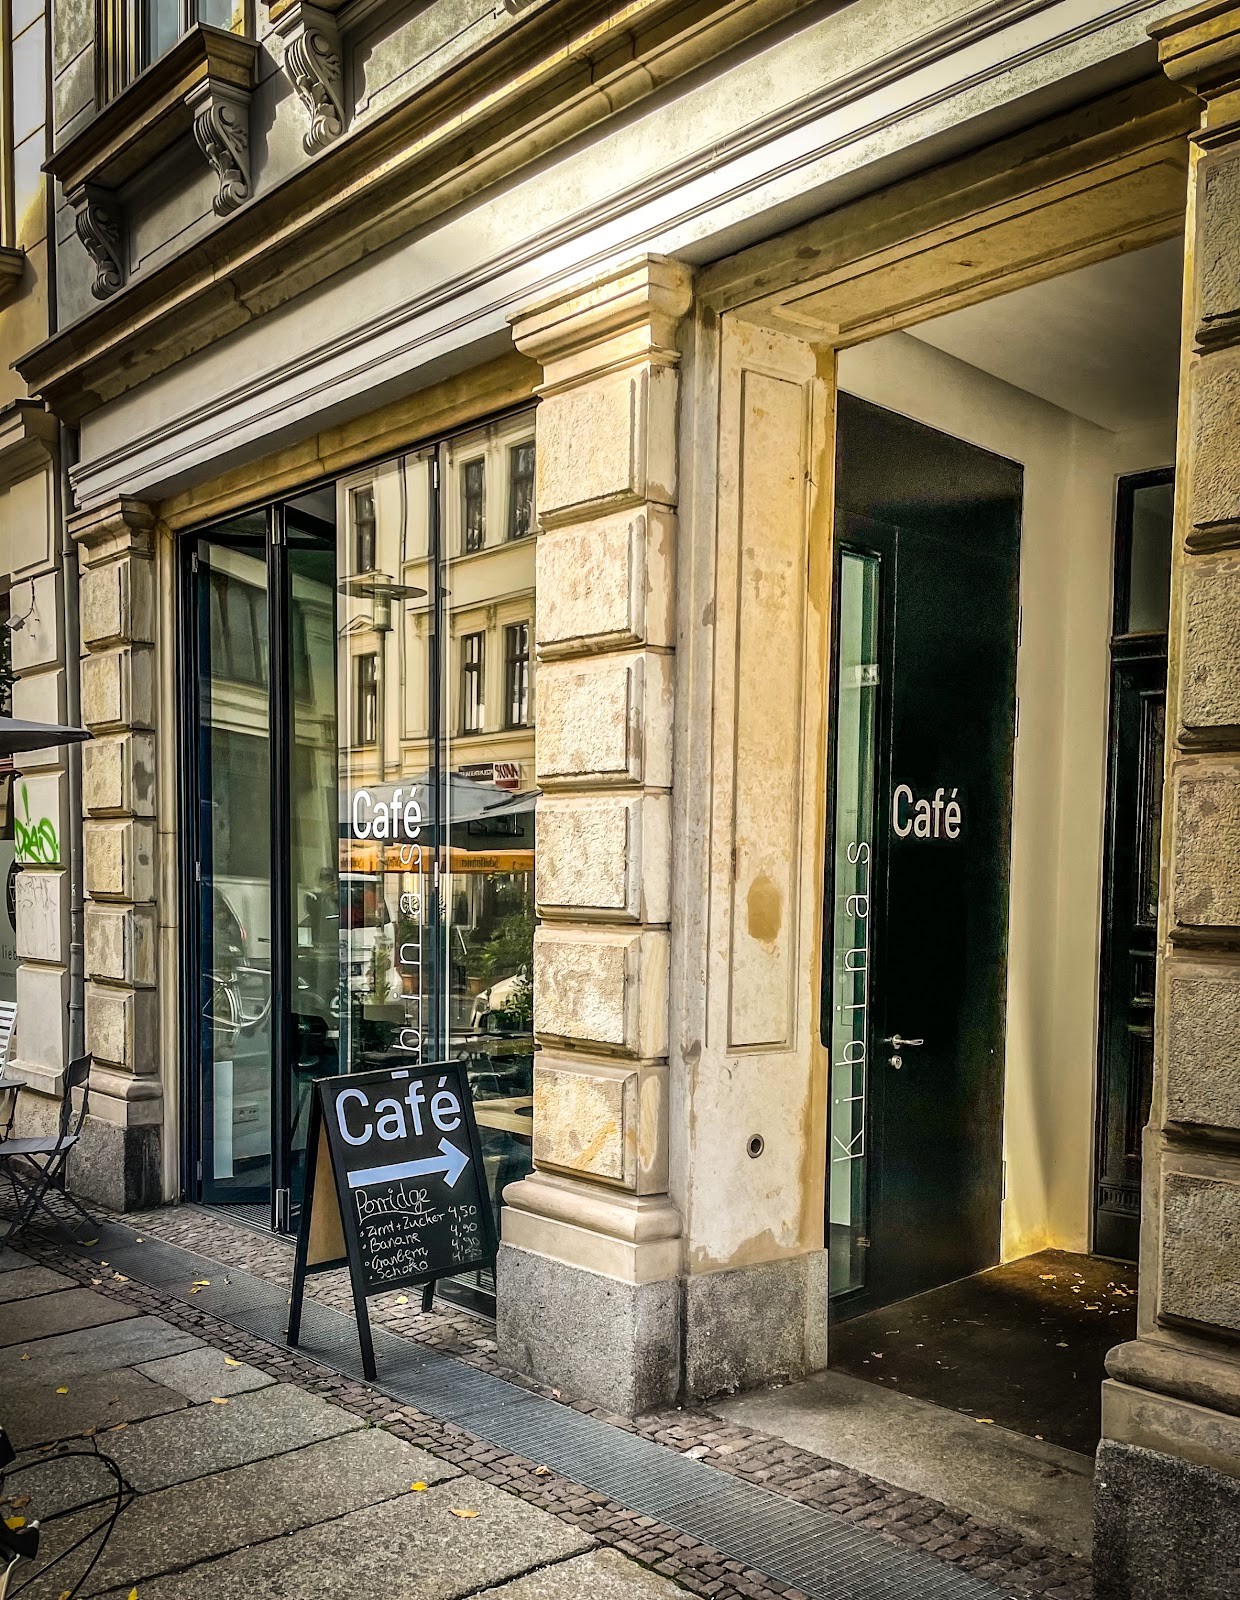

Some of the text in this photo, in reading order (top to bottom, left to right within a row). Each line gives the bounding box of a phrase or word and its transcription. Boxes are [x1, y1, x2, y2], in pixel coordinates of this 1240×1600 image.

[352, 786, 422, 839] Café
[892, 784, 961, 838] Café
[393, 843, 422, 1064] binas
[833, 840, 871, 1162] Kibinas
[335, 1076, 462, 1146] Café
[355, 1183, 431, 1213] Porridge
[448, 1205, 477, 1223] 4,50
[402, 1213, 446, 1230] Zucker
[450, 1222, 478, 1237] 4,90
[370, 1232, 421, 1253] Banane
